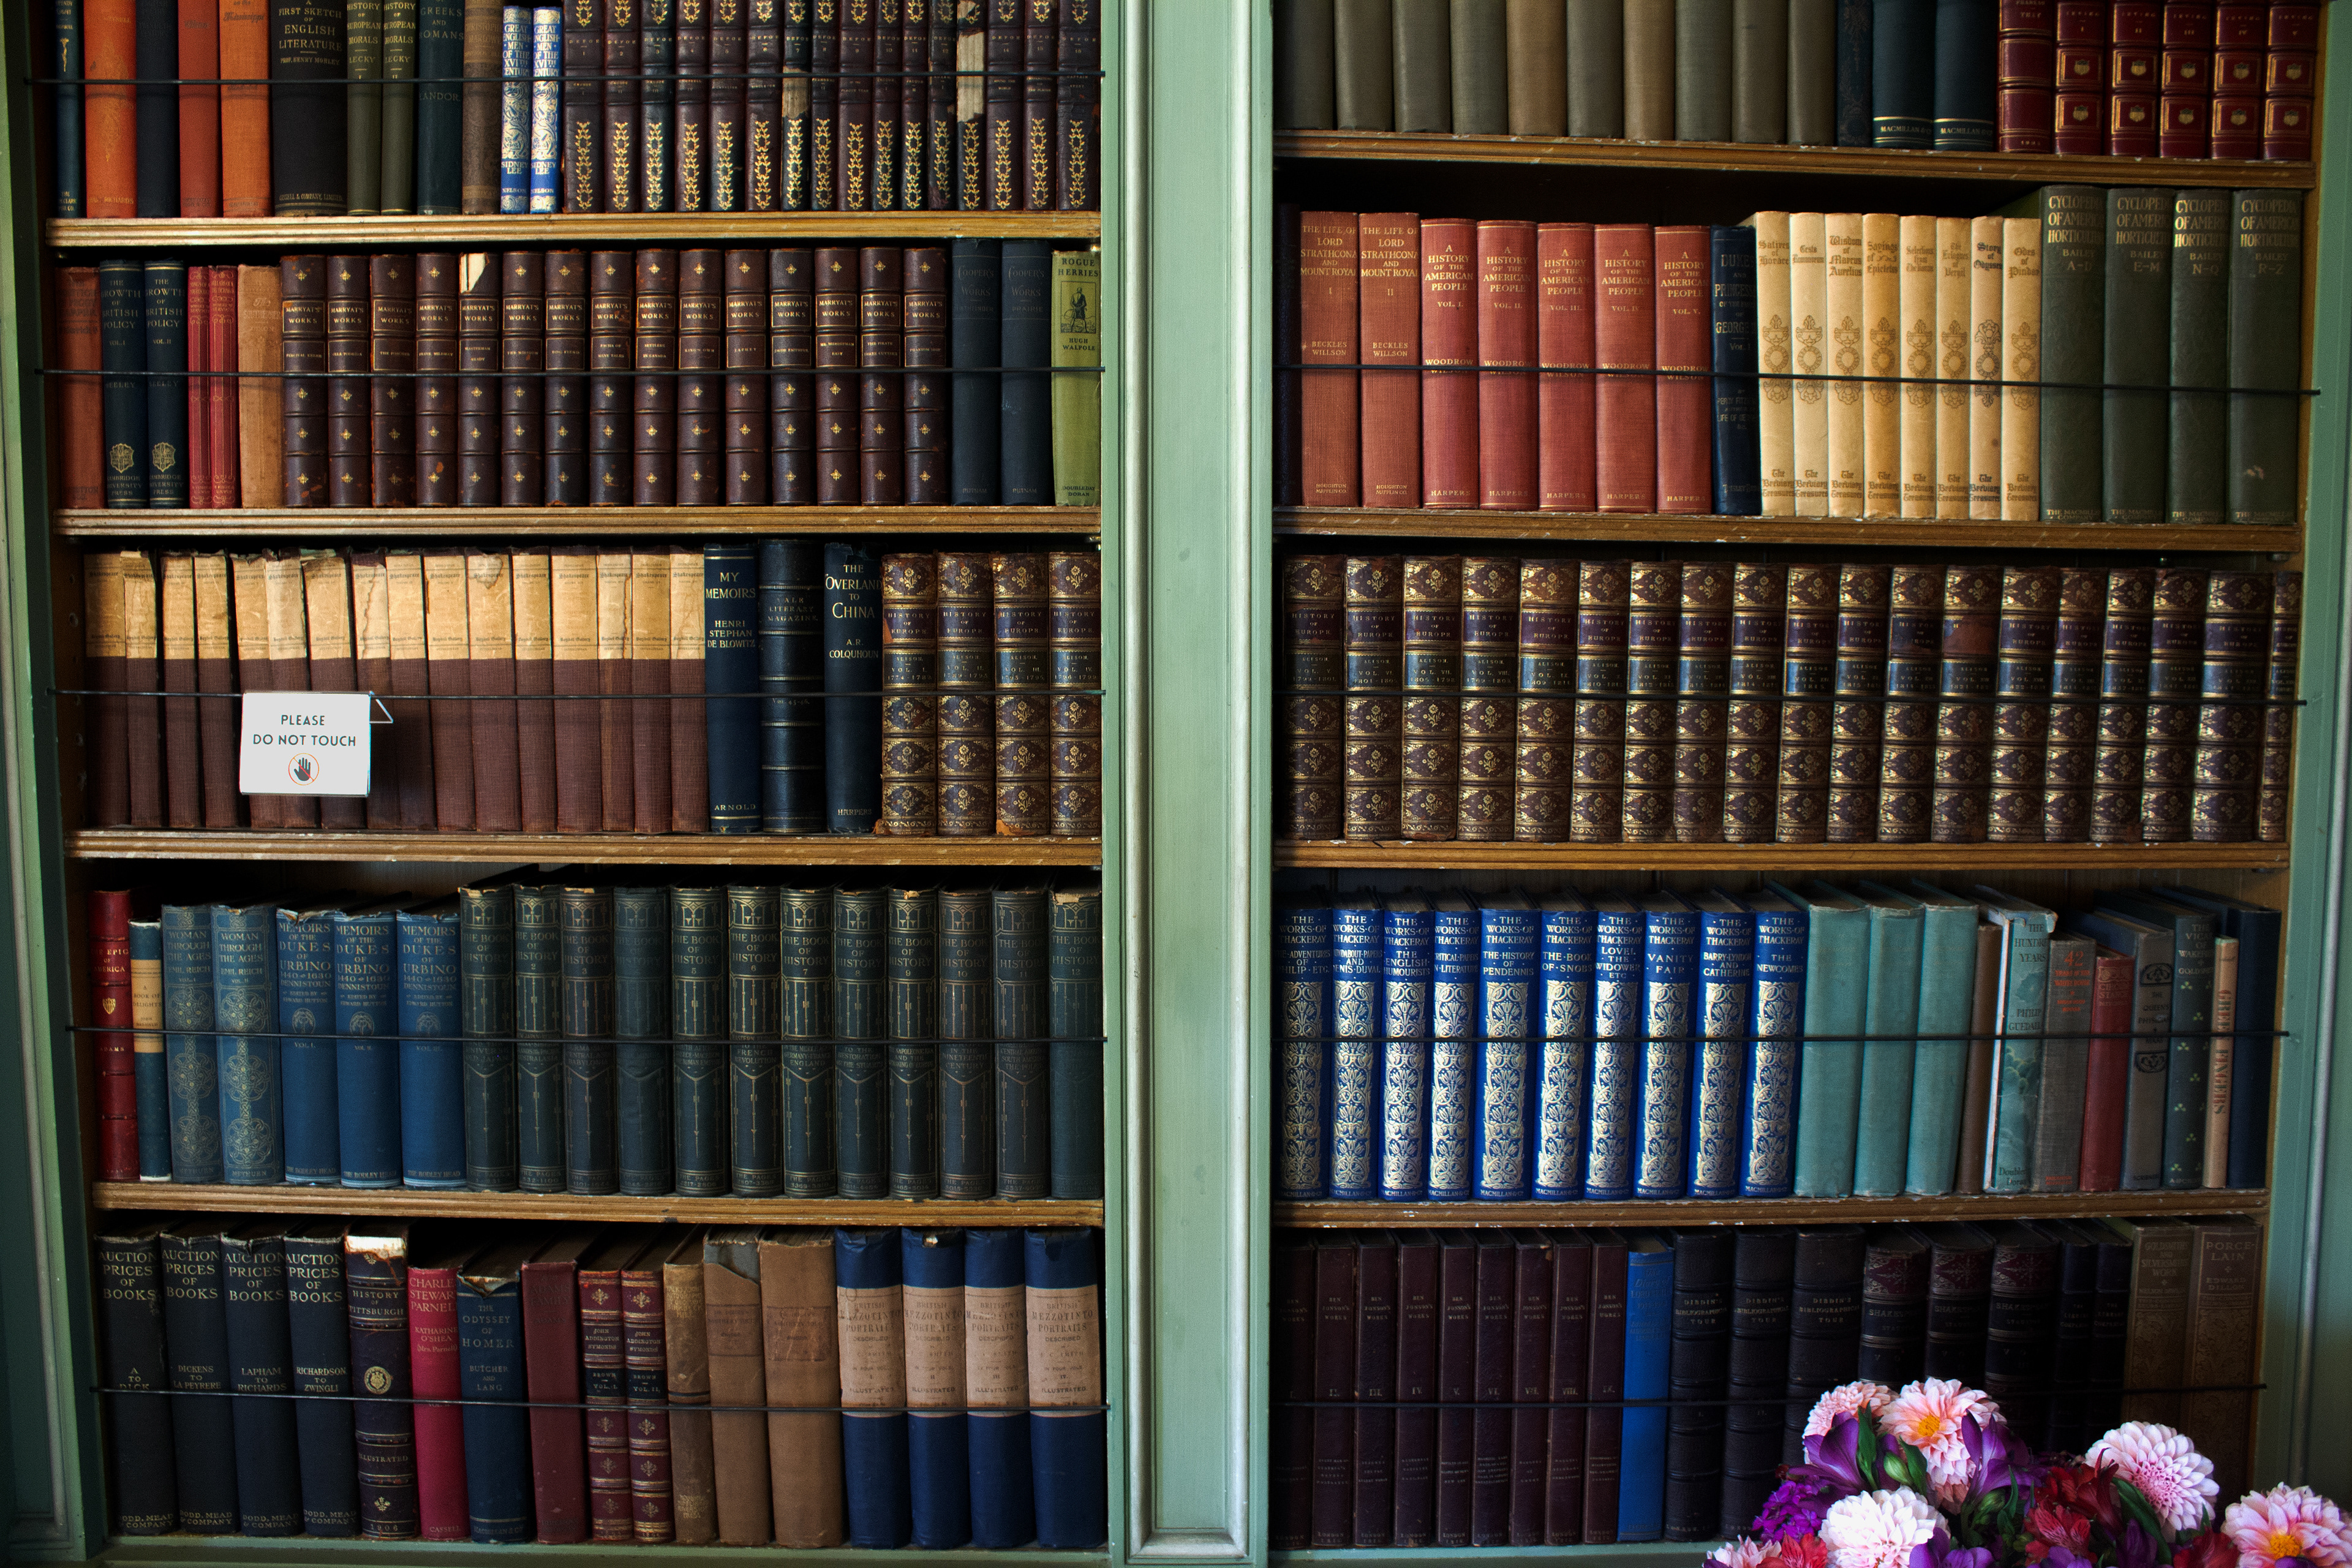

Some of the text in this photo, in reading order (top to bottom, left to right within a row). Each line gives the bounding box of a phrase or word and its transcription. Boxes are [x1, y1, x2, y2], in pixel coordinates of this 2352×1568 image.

[347, 2, 380, 12] HISTORY
[383, 2, 415, 12] HISTORY
[420, 7, 462, 17] GREEKS
[279, 7, 342, 18] FIRST SKETCH
[285, 24, 336, 36] ENGLISH
[504, 24, 528, 33] GREAT
[533, 24, 556, 34] GREAT
[279, 39, 342, 51] LITERATURE
[349, 36, 378, 45] MORALS
[384, 36, 413, 45] MORALS
[1880, 125, 1920, 134] MACMILLAN
[1302, 225, 1343, 234] THE LIFE
[1363, 227, 1405, 235] THE LIFE
[1317, 237, 1343, 246] LORD
[1378, 238, 1404, 247] LORD
[1061, 258, 1095, 267] ROGUE
[1428, 254, 1470, 263] HISTORY
[1544, 258, 1586, 268] HISTORY
[1058, 268, 1098, 277] HERRIES
[1361, 268, 1392, 278] MOUNT
[1425, 271, 1473, 281] AMERICAN
[1431, 282, 1468, 292] PEOPLE
[1547, 287, 1584, 296] PEOPLE
[147, 319, 179, 328] POLICY
[843, 564, 865, 574] THE
[719, 571, 741, 582] MY
[706, 587, 756, 600] MEMOIRS
[831, 601, 875, 619] CHINA
[709, 629, 753, 638] STEPHAN
[707, 639, 756, 648] DE BLOWITZ
[829, 650, 880, 660] COLQUHOUN
[281, 715, 325, 726] PLEASE
[254, 734, 356, 747] DO NOT TOUCH
[837, 808, 873, 816] HARPERS
[336, 925, 389, 936] MEMOIRS
[402, 925, 456, 936] MEMOIRS
[750, 933, 778, 942] BOOK
[220, 943, 262, 952] THROUGH
[336, 944, 389, 955] DUKES
[403, 944, 456, 955] DUKES
[1602, 946, 1633, 955] LOVEL
[220, 954, 263, 963] THE AGES
[732, 953, 777, 962] HISTORY
[1648, 953, 1693, 963] VANITY
[2064, 951, 2084, 967] 42
[1385, 959, 1428, 967] ENGLISH
[1596, 963, 1640, 971] WIDOWER
[1757, 963, 1803, 973] NEWCOMES
[337, 963, 389, 974] URBINO
[403, 963, 456, 974] URBINO
[1383, 967, 1430, 976] HUMOURISTS
[1483, 967, 1534, 976] PENDENNIS
[1656, 965, 1685, 974] FAIR
[1703, 968, 1751, 978] CATHERINE
[161, 1249, 219, 1261] AUCTION
[166, 1263, 216, 1275] PRICES
[290, 1266, 340, 1279] PRICES
[182, 1276, 198, 1286] OF
[306, 1281, 322, 1290] OF
[167, 1287, 218, 1299] BOOKS
[290, 1290, 343, 1303] BOOKS
[352, 1289, 399, 1299] HISTORY
[462, 1315, 511, 1324] ODYSSEY
[462, 1338, 515, 1349] HOMER
[179, 1365, 214, 1374] DICKENS
[241, 1367, 281, 1376] LAPHAM
[296, 1366, 347, 1376] RICHARDSON
[304, 1383, 339, 1392] ZWINGLI
[429, 1525, 461, 1533] CASSELL
